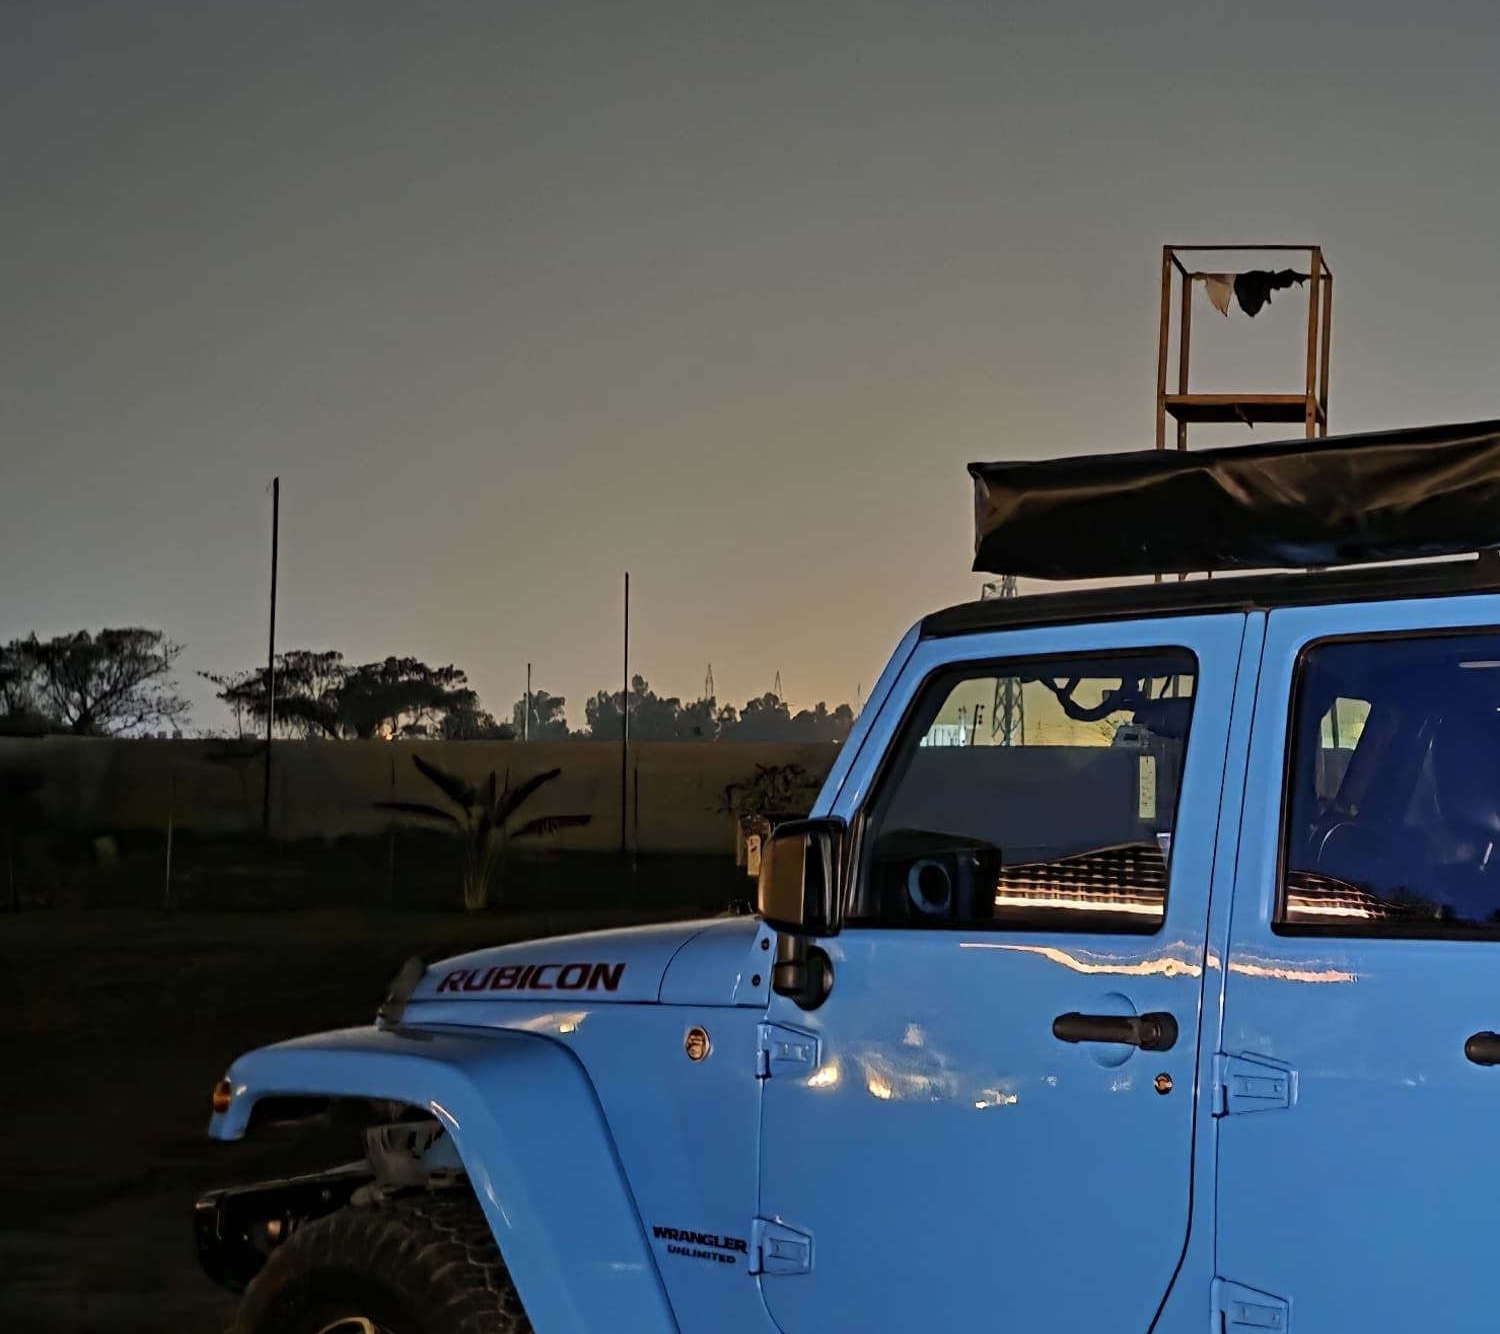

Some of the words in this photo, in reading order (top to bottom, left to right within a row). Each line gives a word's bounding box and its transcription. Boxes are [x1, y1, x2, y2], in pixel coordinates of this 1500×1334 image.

[436, 962, 627, 994] RUBICON
[652, 1225, 748, 1254] WRANGLER
[666, 1244, 737, 1264] UNLIMITED
